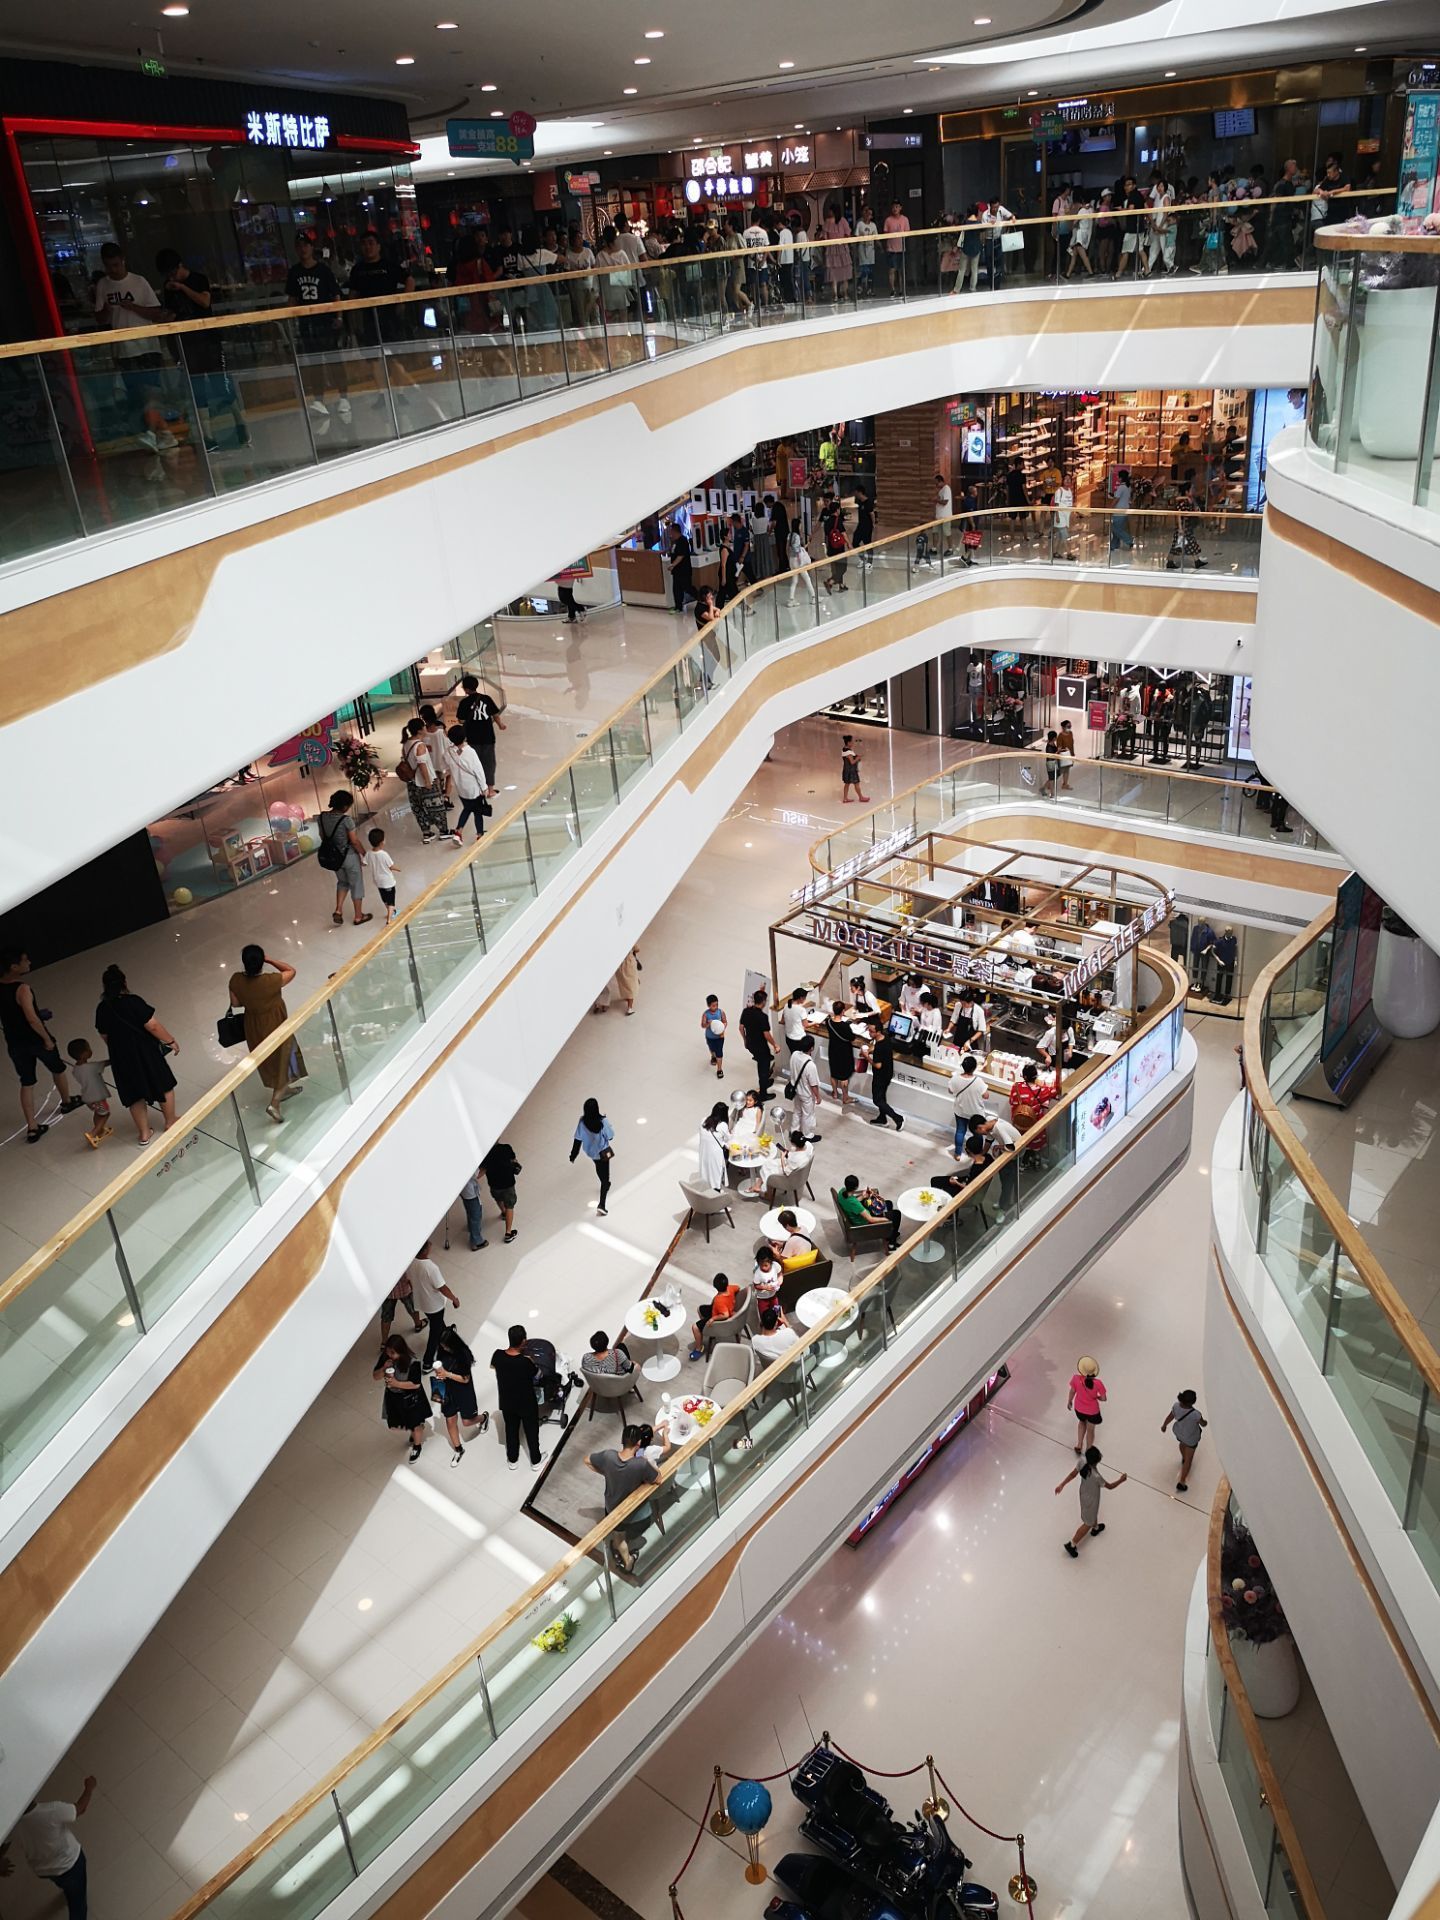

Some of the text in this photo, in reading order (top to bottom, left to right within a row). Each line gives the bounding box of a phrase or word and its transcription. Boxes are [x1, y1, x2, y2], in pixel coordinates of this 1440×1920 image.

[247, 110, 330, 148] 米斯特比萨
[495, 136, 518, 152] 88
[301, 285, 319, 300] 23
[892, 937, 943, 972] TEE
[1063, 943, 1113, 1000] MÖGE
[1111, 917, 1142, 958] TEE
